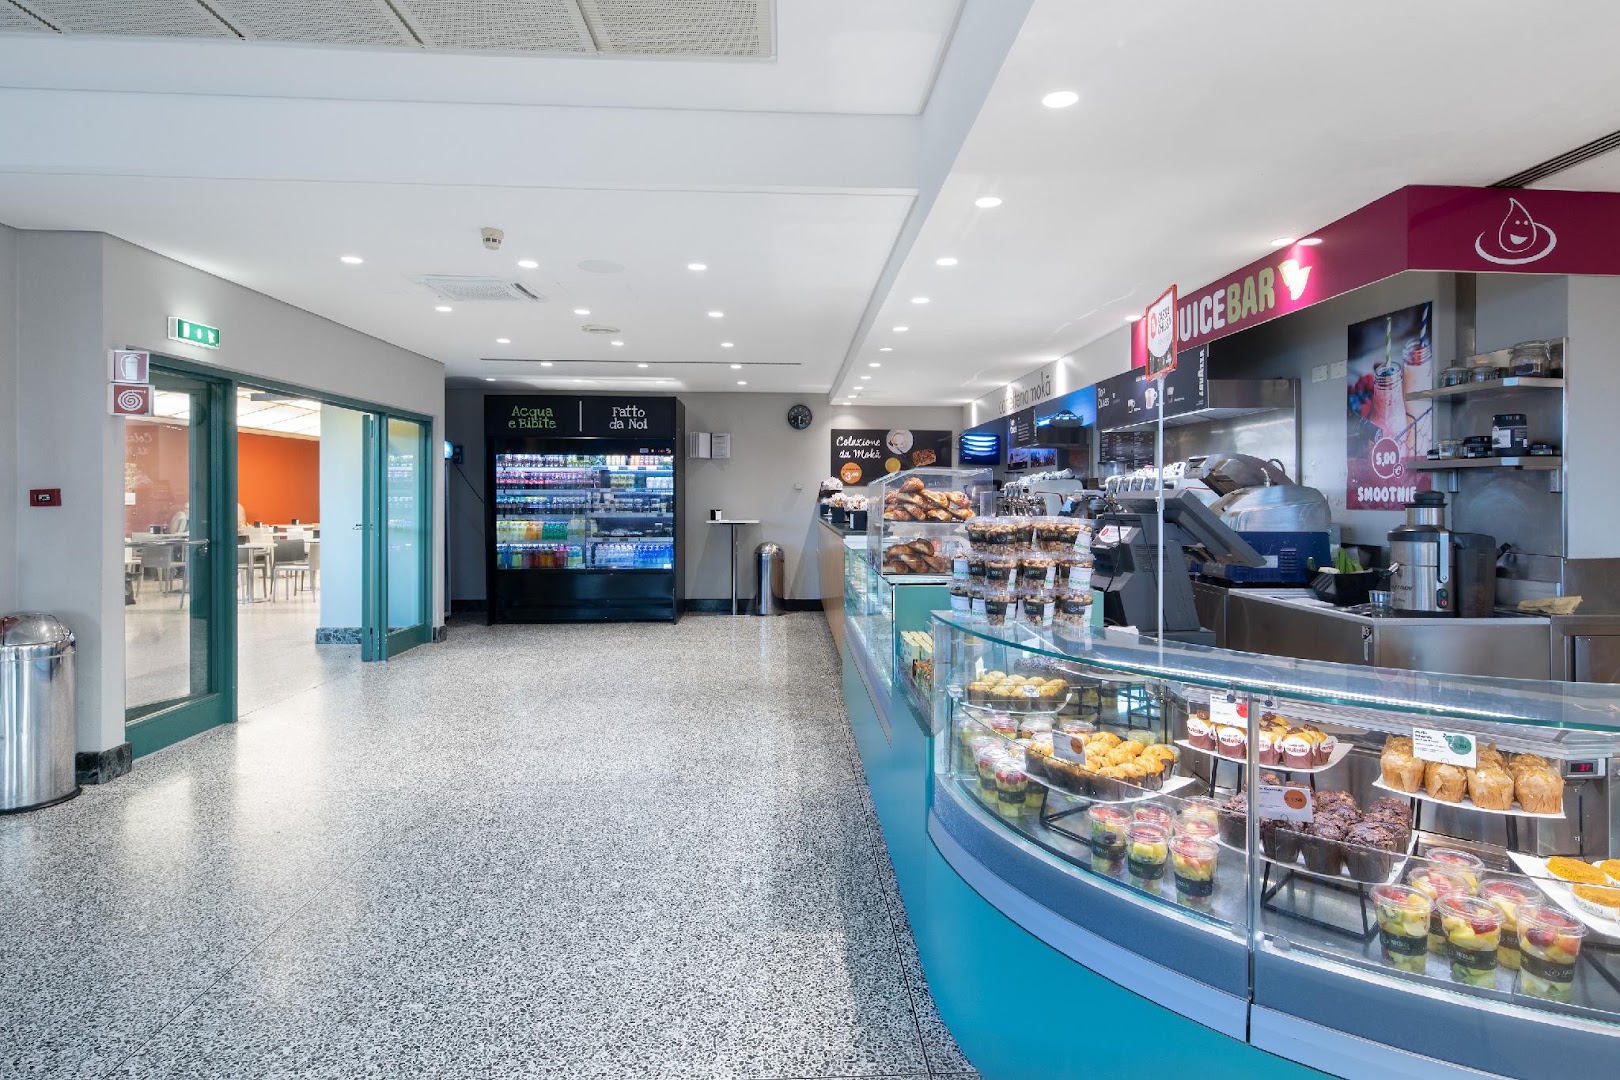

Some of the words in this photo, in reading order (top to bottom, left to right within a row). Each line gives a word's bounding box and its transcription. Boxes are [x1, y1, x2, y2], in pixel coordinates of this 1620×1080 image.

[1177, 267, 1275, 342] UICEBAR
[511, 405, 553, 420] Acqua
[612, 405, 646, 417] Fatto
[519, 417, 557, 428] Bibite
[609, 418, 624, 429] da
[628, 418, 648, 429] Noi
[836, 436, 881, 446] Colazione
[839, 449, 851, 459] da
[1376, 451, 1397, 467] 5,00
[1357, 486, 1417, 502] SMOOTHIE
